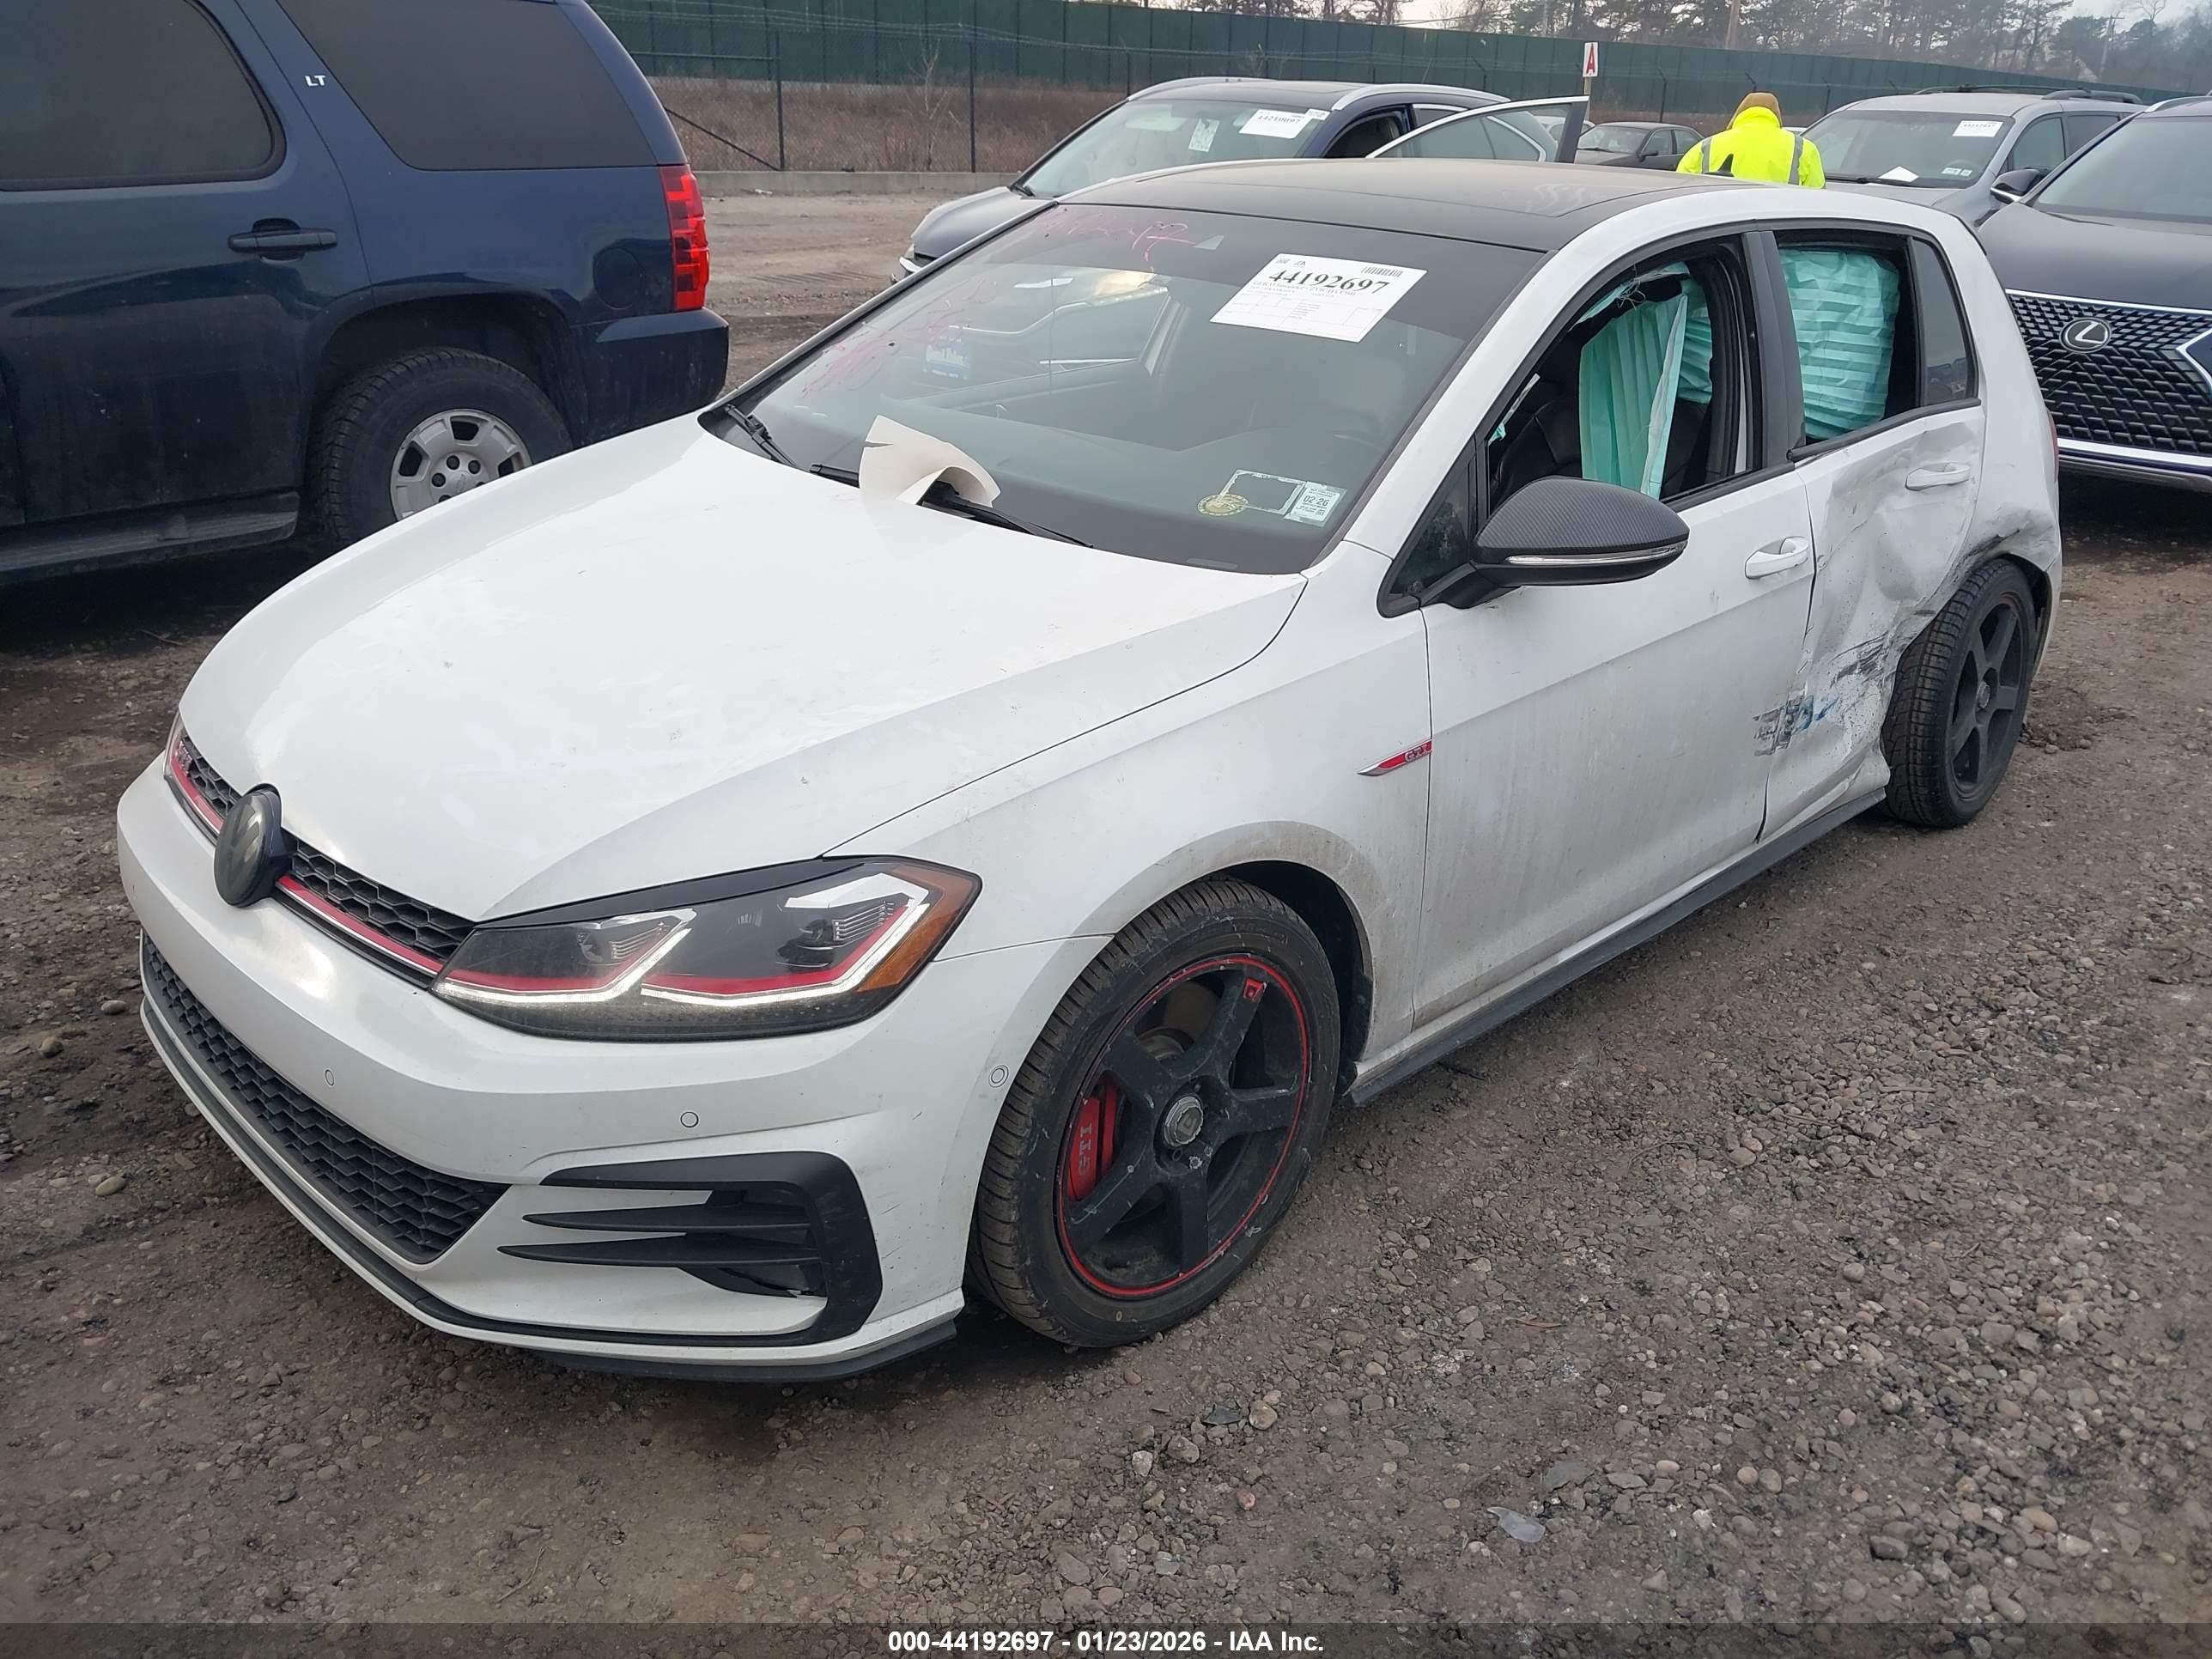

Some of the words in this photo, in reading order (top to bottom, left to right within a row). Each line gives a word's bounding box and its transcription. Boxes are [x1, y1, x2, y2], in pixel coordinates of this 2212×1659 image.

[1586, 43, 1595, 74] A
[305, 75, 326, 87] LT
[1268, 269, 1390, 295] 44192697
